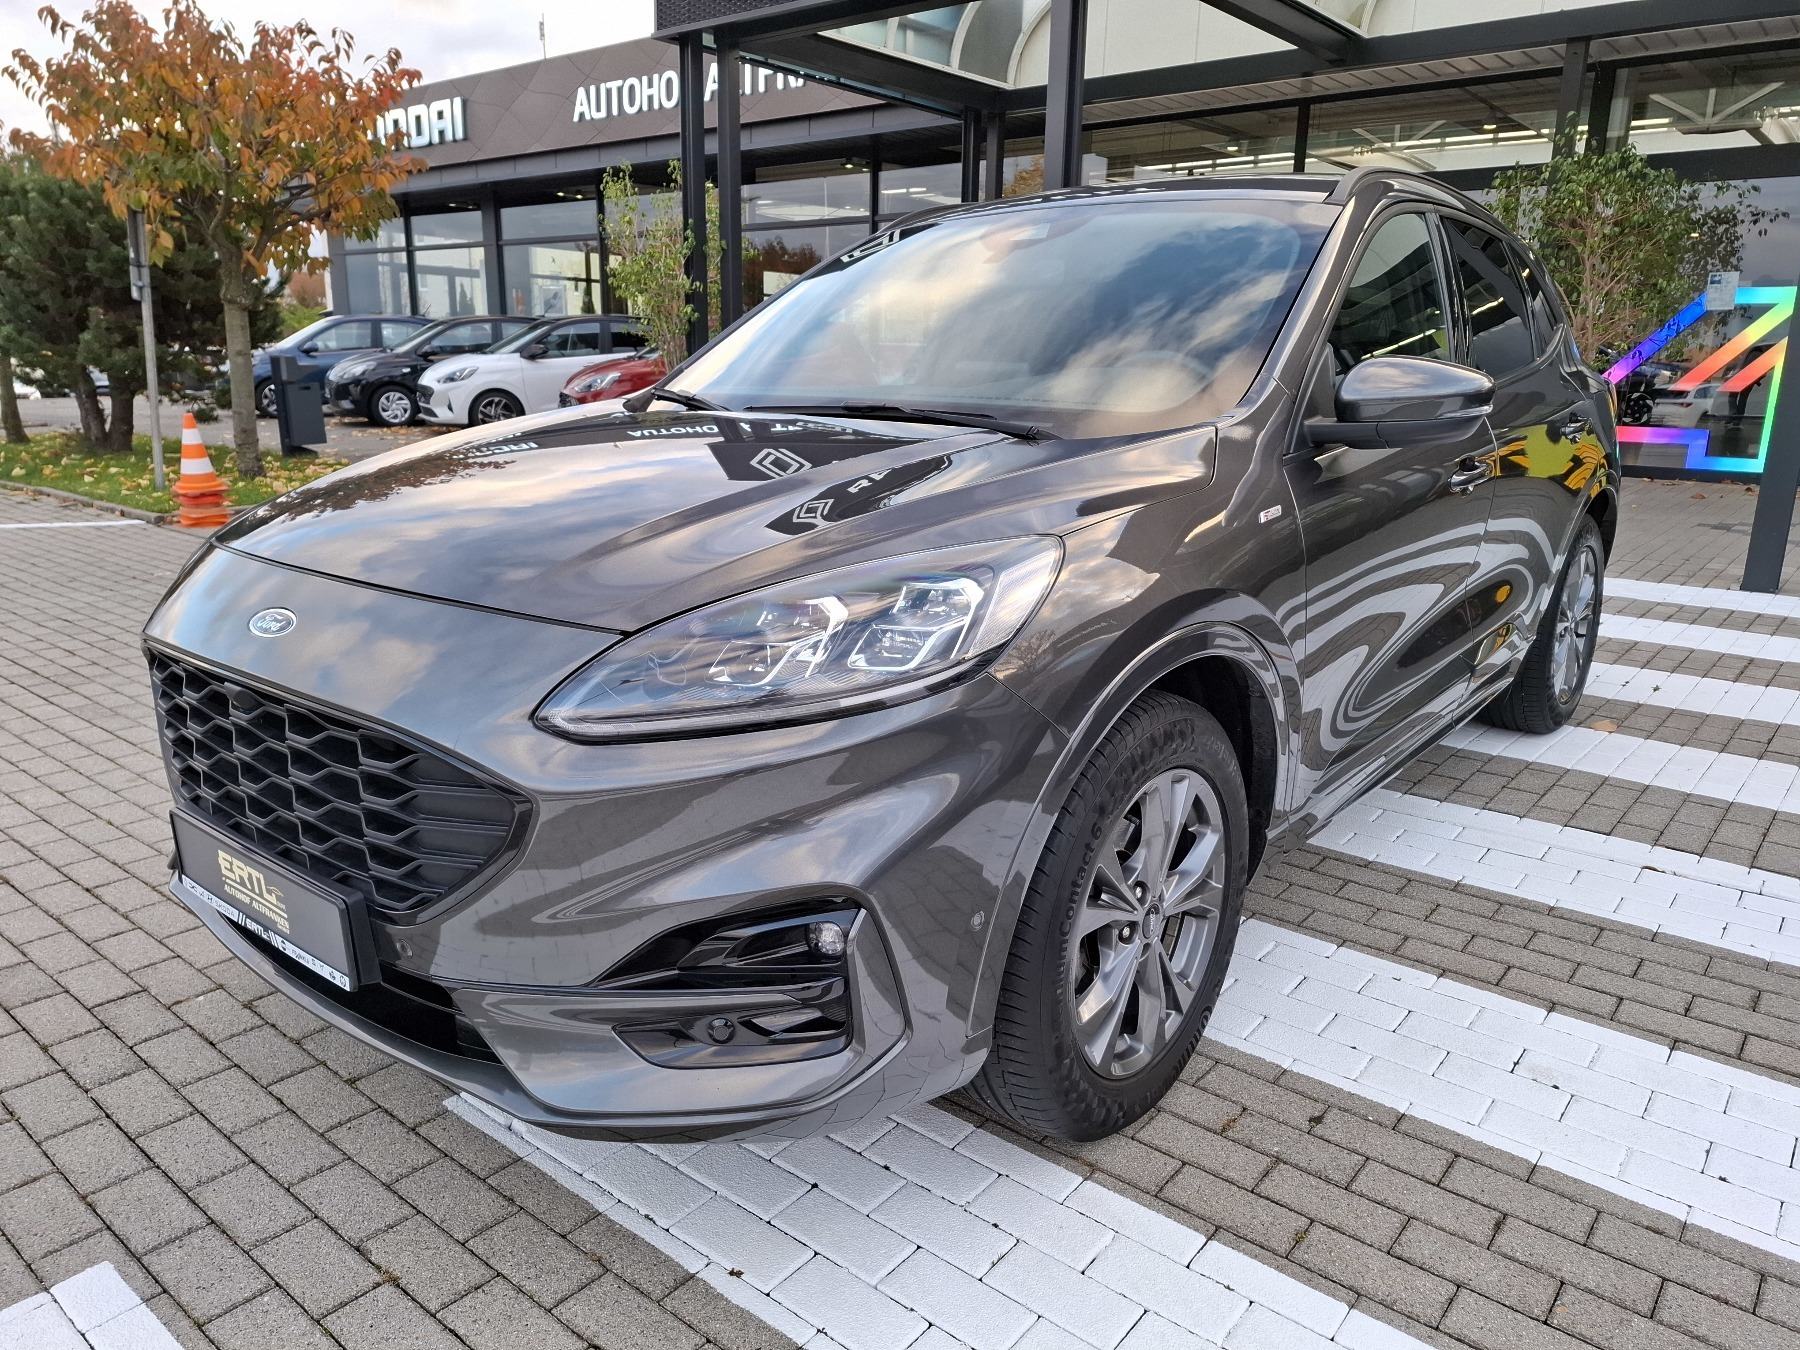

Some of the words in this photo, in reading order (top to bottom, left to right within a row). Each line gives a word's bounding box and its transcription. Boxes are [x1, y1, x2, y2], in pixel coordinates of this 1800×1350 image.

[572, 69, 681, 123] AUTOHO
[218, 849, 277, 904] ERTL
[224, 884, 251, 905] AUTOHOF
